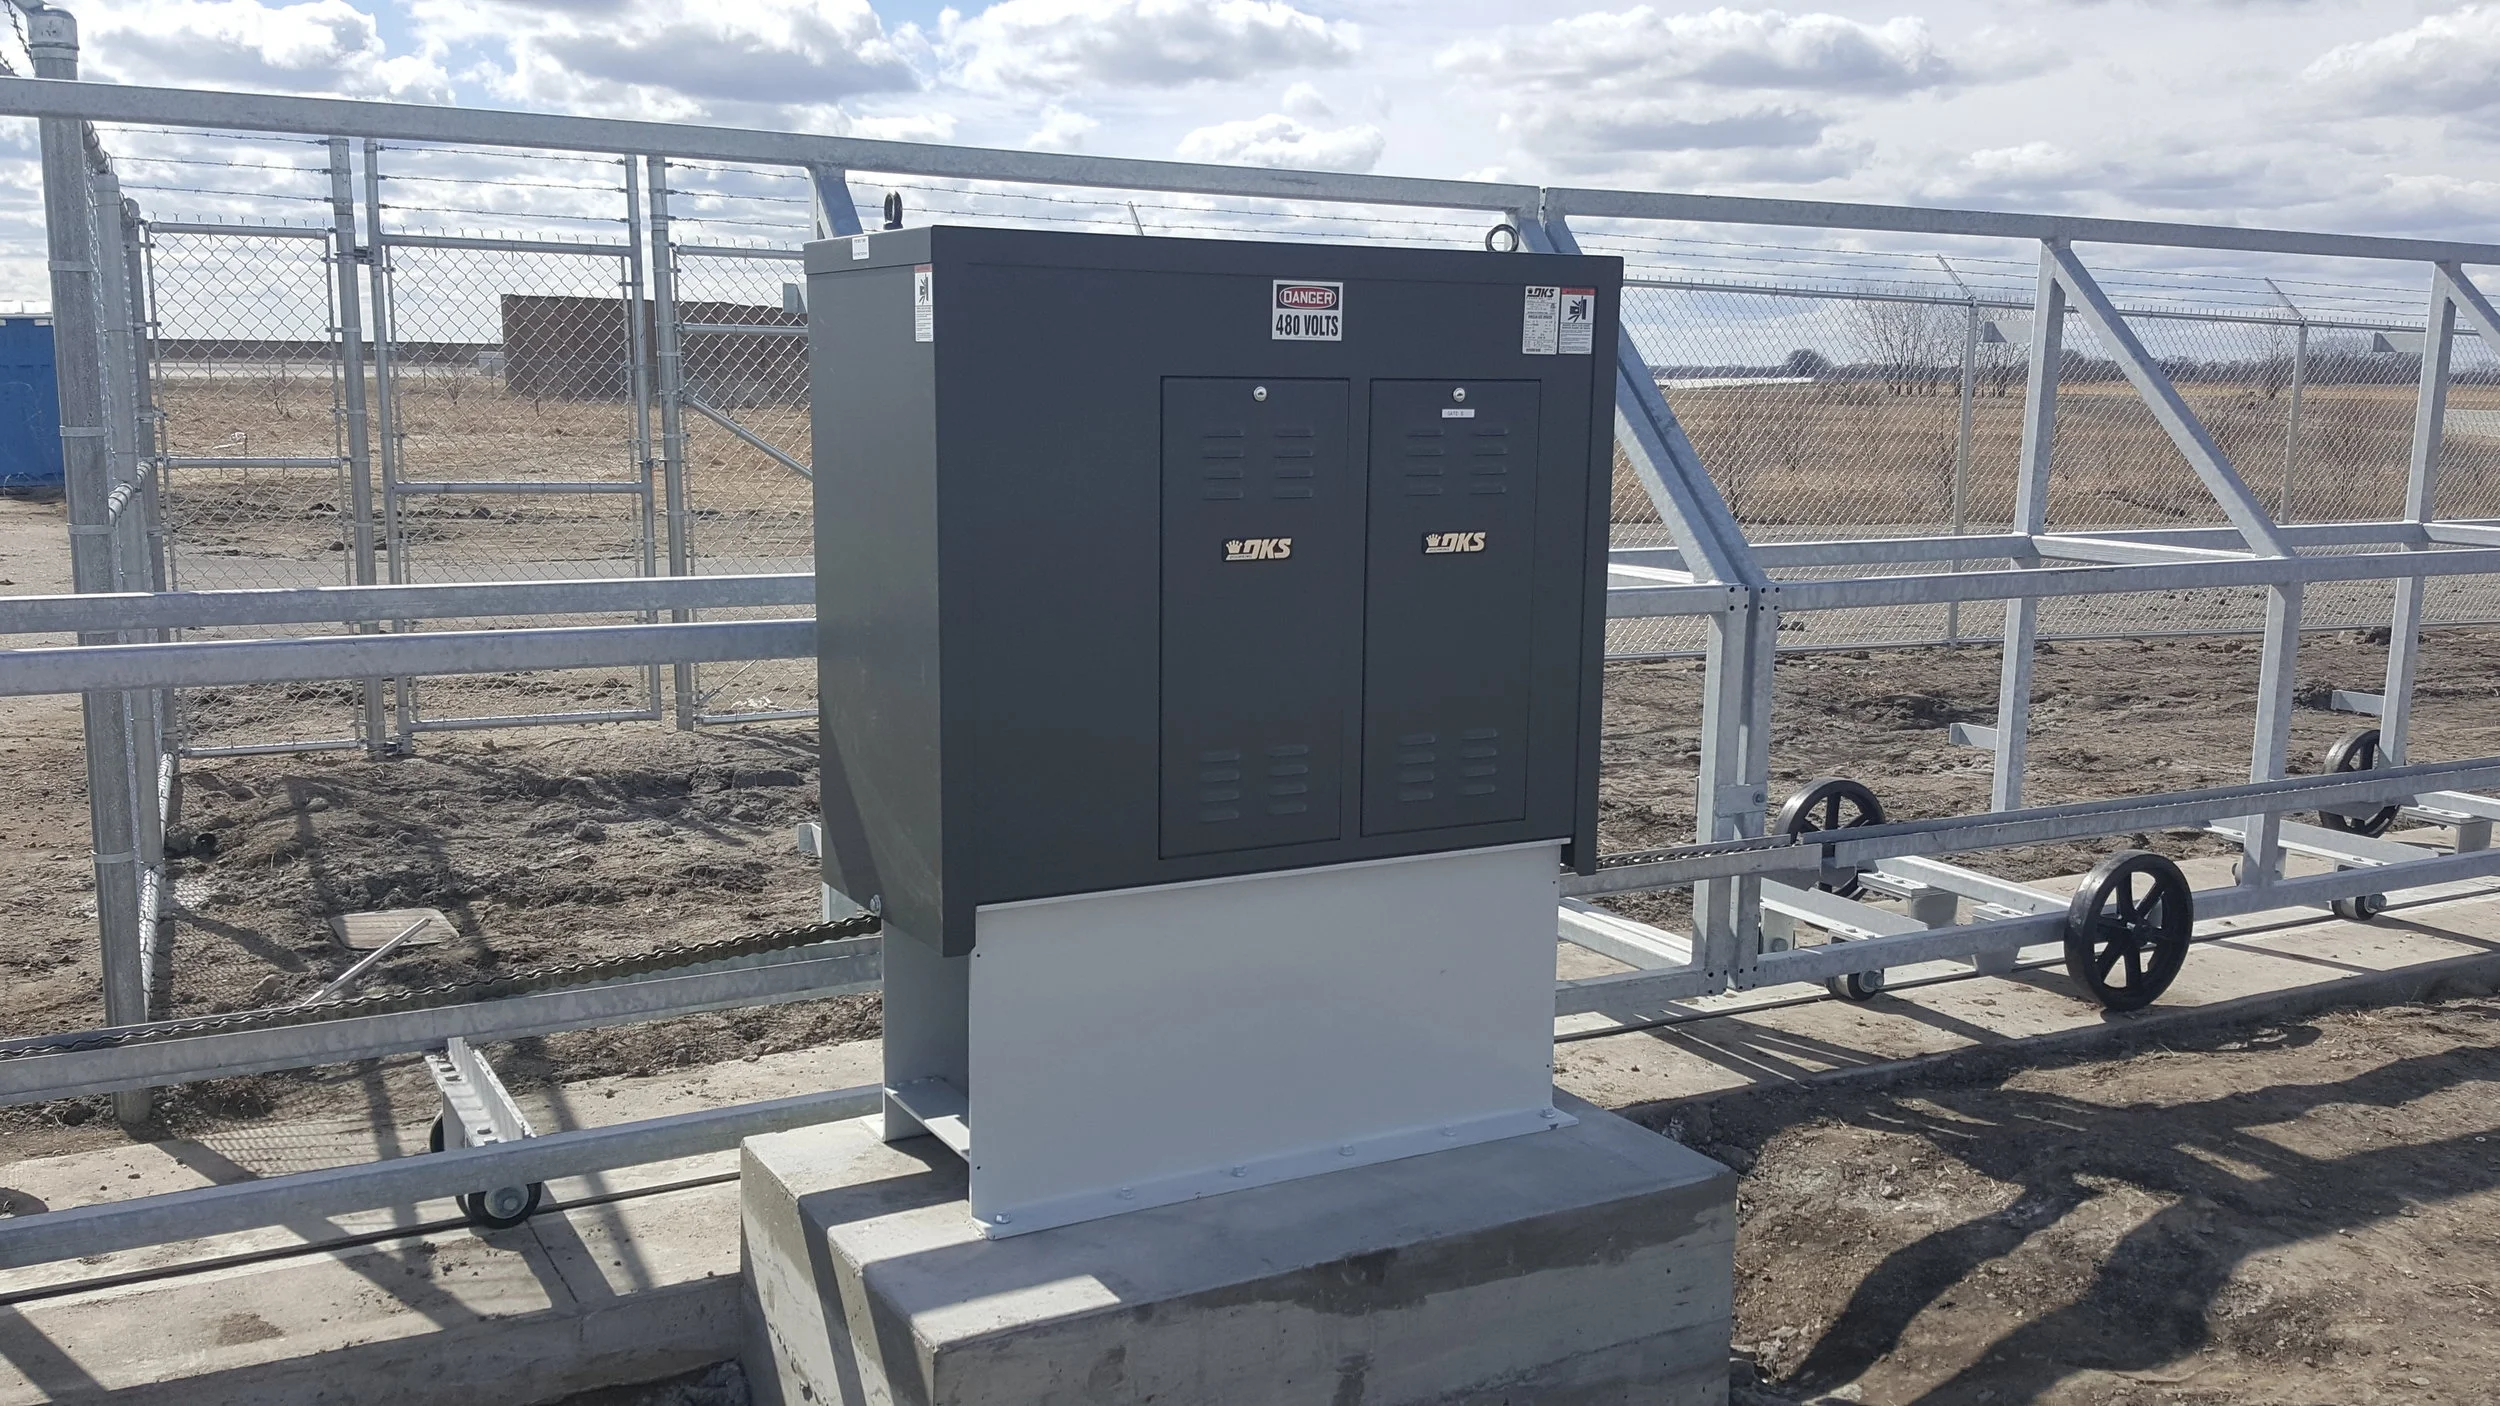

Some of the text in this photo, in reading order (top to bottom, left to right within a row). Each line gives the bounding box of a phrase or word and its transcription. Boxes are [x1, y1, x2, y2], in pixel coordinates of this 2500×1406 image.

[1283, 290, 1333, 305] DANGER
[1529, 288, 1554, 297] DKS
[1276, 314, 1339, 337] 480 VOLTS
[1237, 538, 1292, 560] DKS
[1436, 532, 1486, 552] DKS
